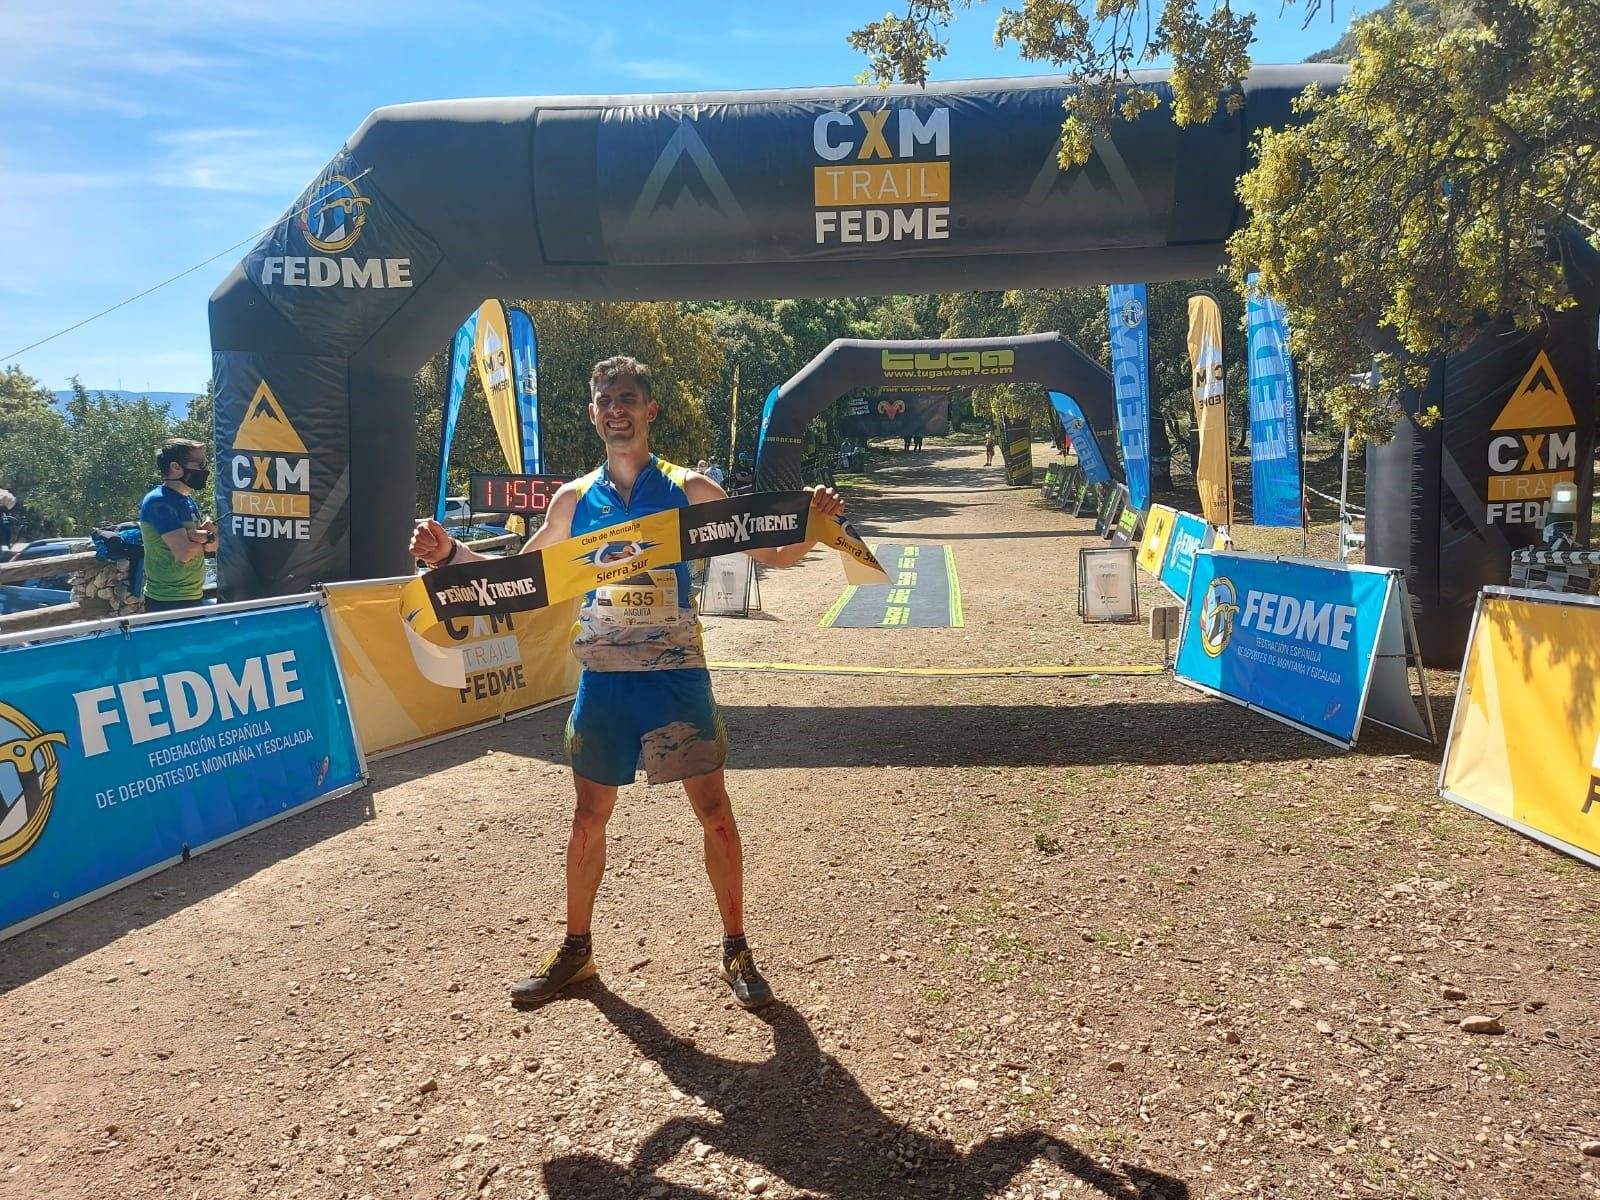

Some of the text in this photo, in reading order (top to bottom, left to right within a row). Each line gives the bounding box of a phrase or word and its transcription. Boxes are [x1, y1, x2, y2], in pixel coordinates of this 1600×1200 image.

[813, 107, 950, 161] CXM
[826, 168, 938, 201] TRAIL
[815, 207, 950, 243] FEDME
[262, 256, 413, 289] FEDME
[881, 349, 1015, 373] tuga
[884, 367, 1013, 378] www.tugawear.com
[1487, 431, 1576, 473] CXM
[231, 454, 310, 491] CXM
[235, 494, 302, 514] TRAIL
[231, 516, 310, 540] FEDME
[581, 522, 641, 546] Club de Montaña
[834, 536, 862, 558] Sierra
[596, 557, 649, 583] Sierra Sur
[621, 591, 655, 607] 435
[623, 608, 652, 617] ANGUITA
[1241, 590, 1357, 651] FEDME
[462, 641, 513, 668] TRAIL
[1289, 646, 1321, 663] ESPAÑOLA
[460, 664, 527, 704] FEDME
[1268, 655, 1277, 666] DE
[1310, 667, 1341, 685] ESCALADA
[72, 650, 305, 758] FEDME
[148, 720, 272, 768] FEDERACIÓN ESPAÑOLA
[96, 728, 314, 809] DE DEPORTES DE MONTAÑA Y ESCALADA
